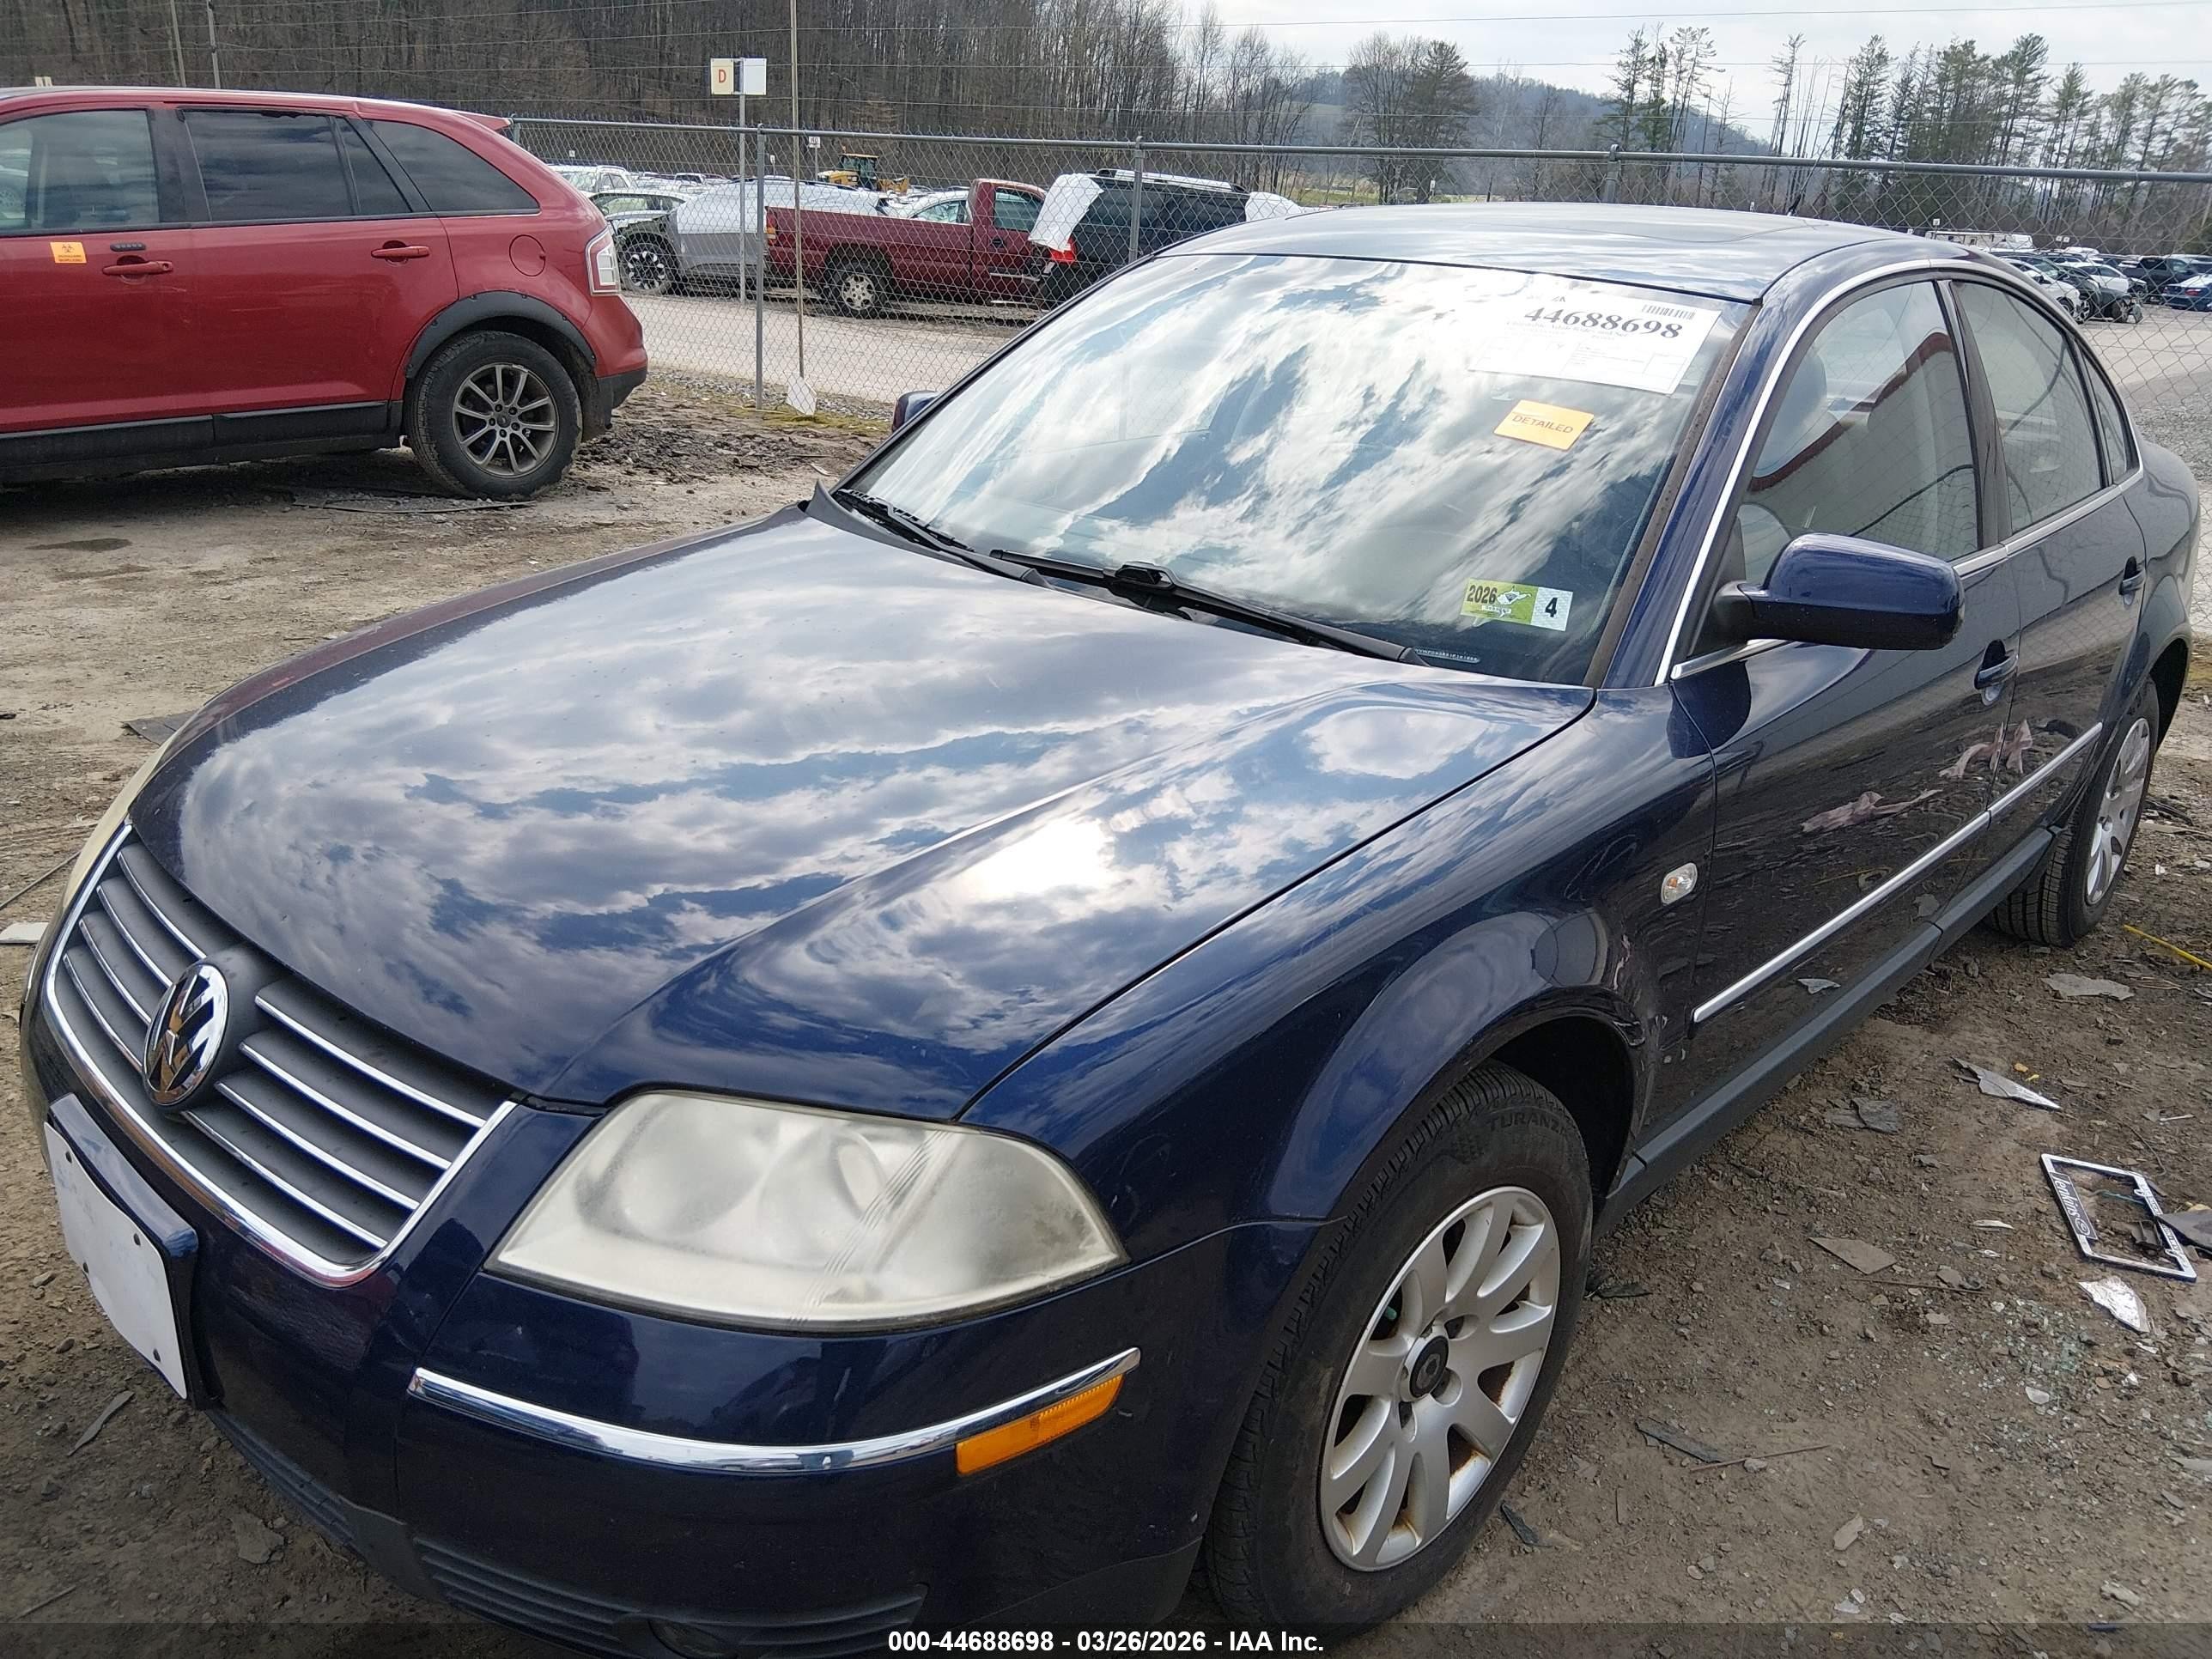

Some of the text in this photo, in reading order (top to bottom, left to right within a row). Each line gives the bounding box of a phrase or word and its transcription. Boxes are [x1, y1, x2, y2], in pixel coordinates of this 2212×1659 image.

[718, 69, 726, 83] D
[1523, 307, 1684, 339] 44688698
[1511, 415, 1574, 434] DETAILED
[1466, 585, 1498, 605] 2026
[1544, 597, 1559, 618] 4
[2051, 1173, 2081, 1218] Jenkins
